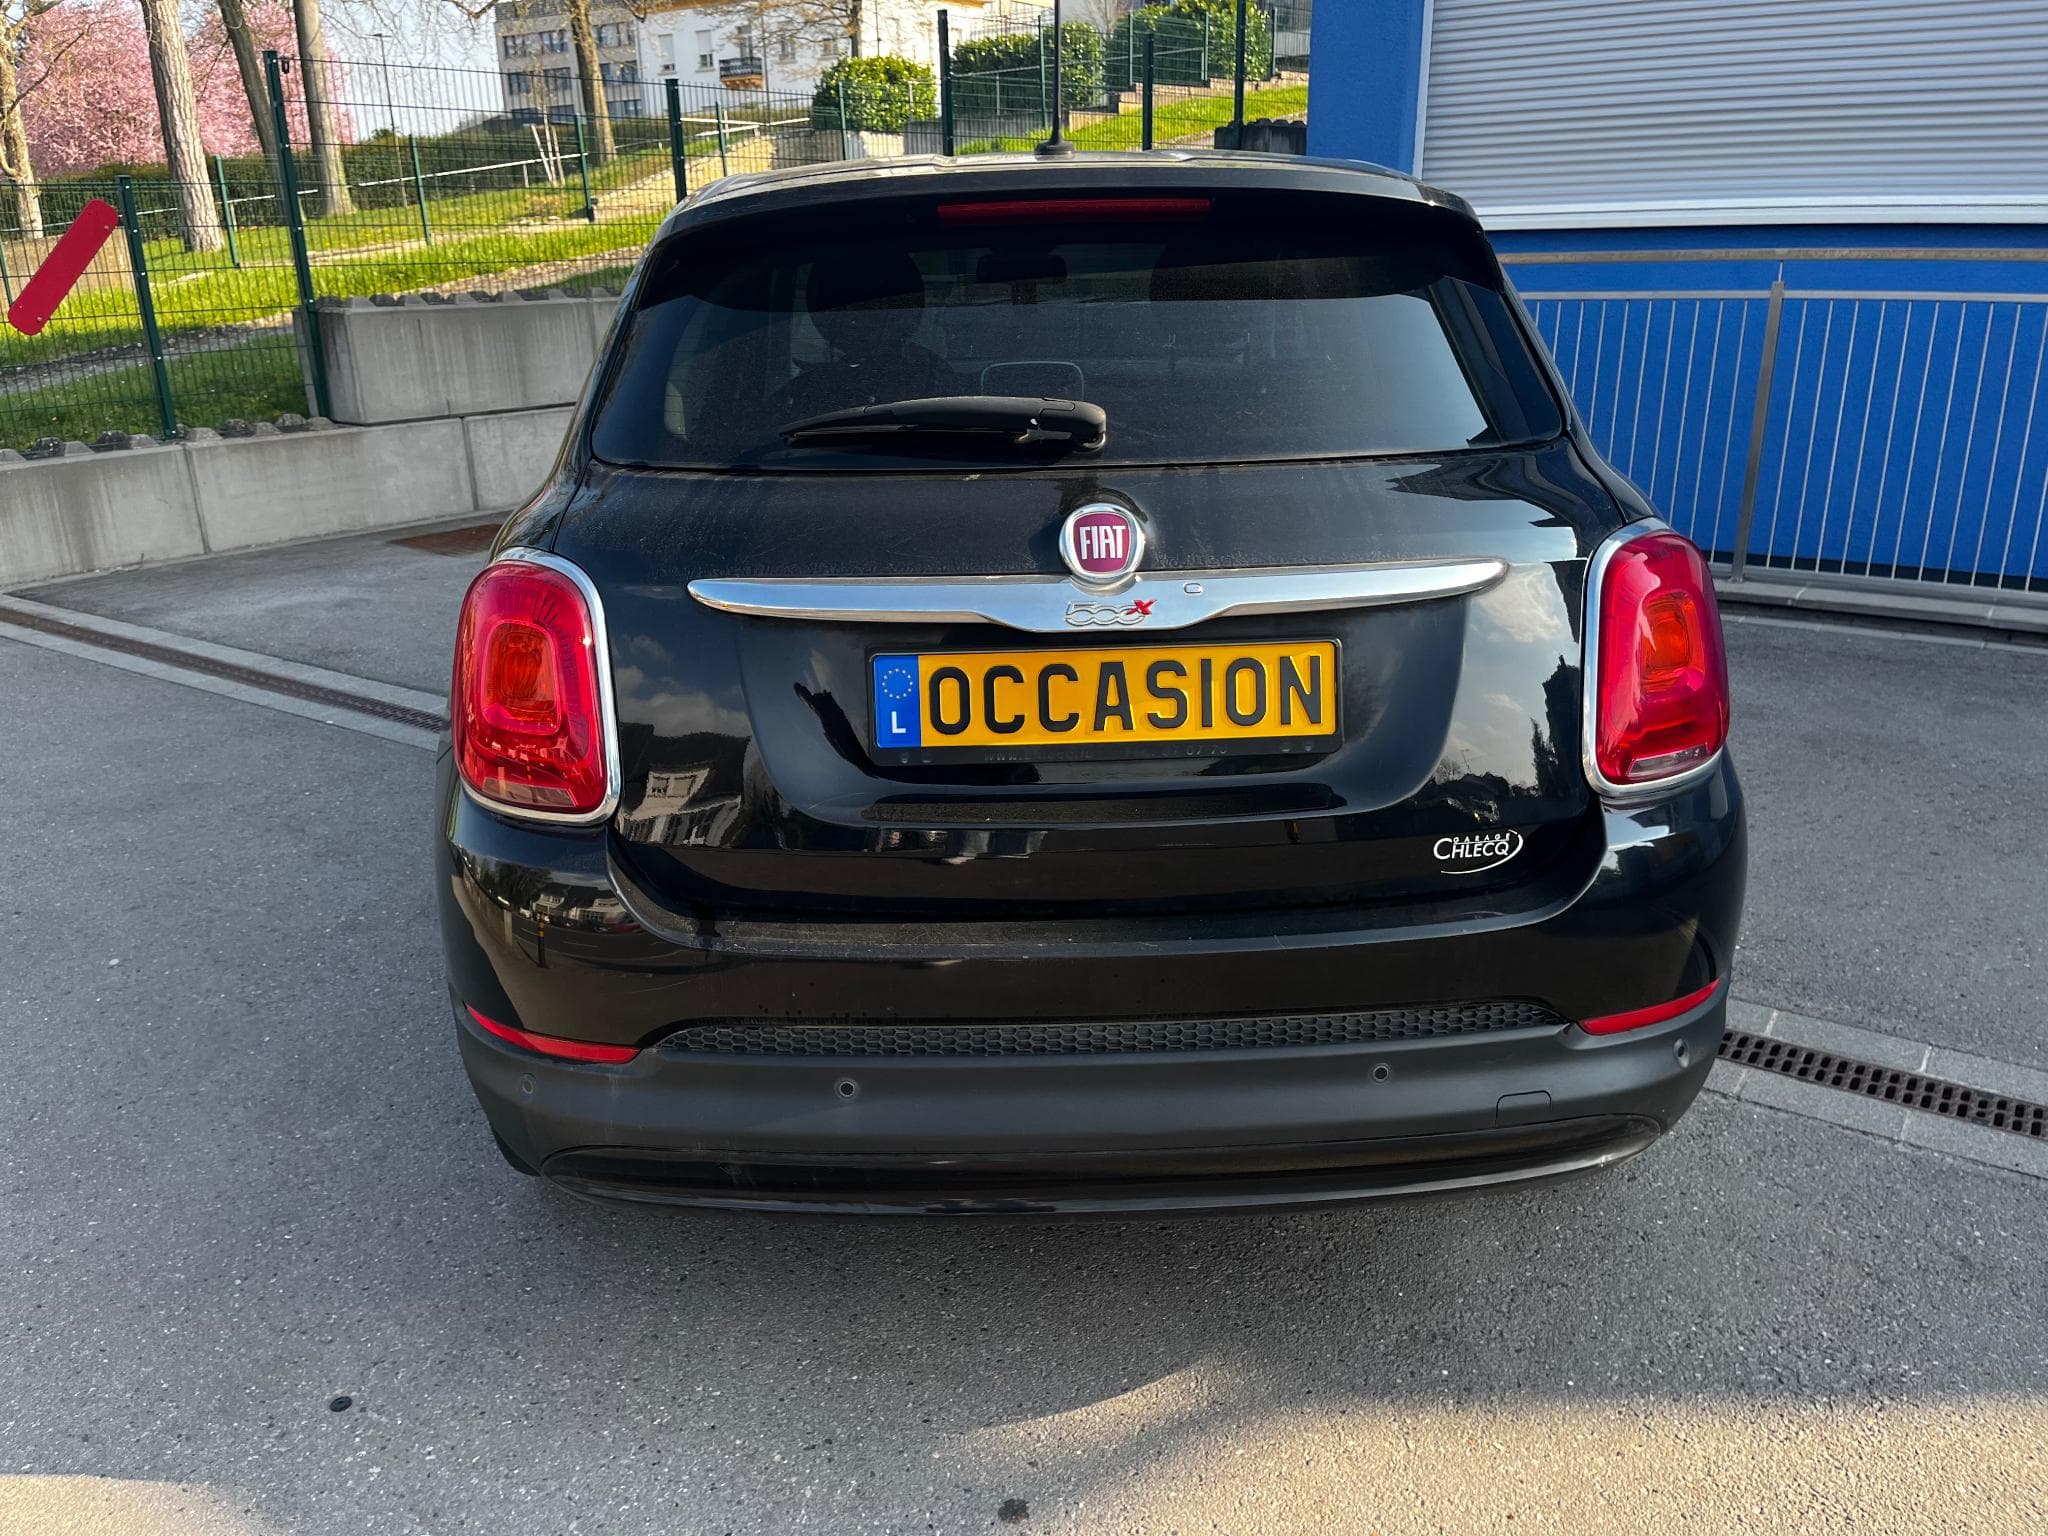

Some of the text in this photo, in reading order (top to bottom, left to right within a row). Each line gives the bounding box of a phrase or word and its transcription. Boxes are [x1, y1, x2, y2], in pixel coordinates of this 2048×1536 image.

[1079, 525, 1127, 560] FIAT
[928, 655, 1323, 736] OCCASION
[891, 711, 907, 734] L
[1433, 837, 1510, 860] CHLECQ
[1453, 833, 1511, 843] GARAGE
